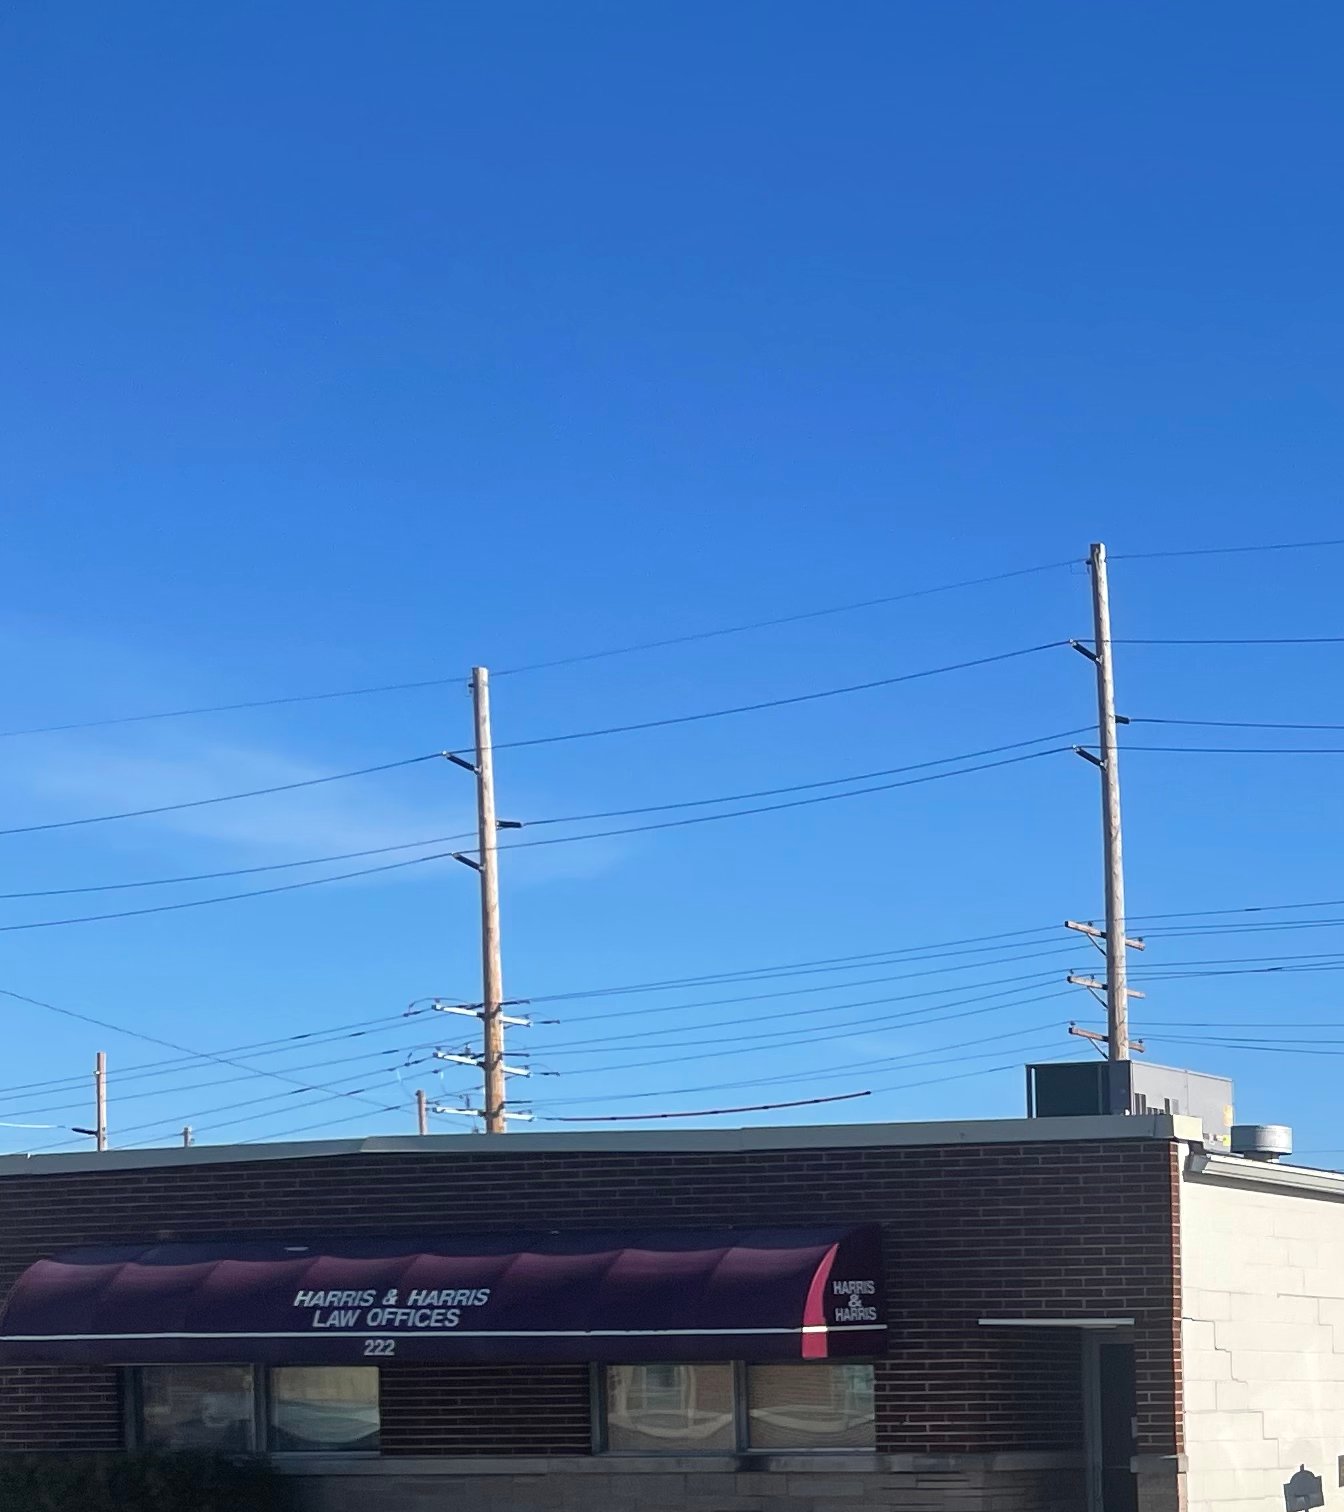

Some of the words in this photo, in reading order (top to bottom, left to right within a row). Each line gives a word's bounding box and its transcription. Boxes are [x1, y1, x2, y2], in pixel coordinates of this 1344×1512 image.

[833, 1280, 876, 1295] HARRIS
[293, 1290, 376, 1307] HARRIS
[382, 1288, 398, 1306] &
[407, 1288, 490, 1306] HARRIS
[848, 1294, 862, 1308] &
[312, 1309, 361, 1327] LAW
[365, 1308, 461, 1327] OFFICES
[834, 1306, 877, 1322] HARRIS
[363, 1339, 395, 1356] 222
